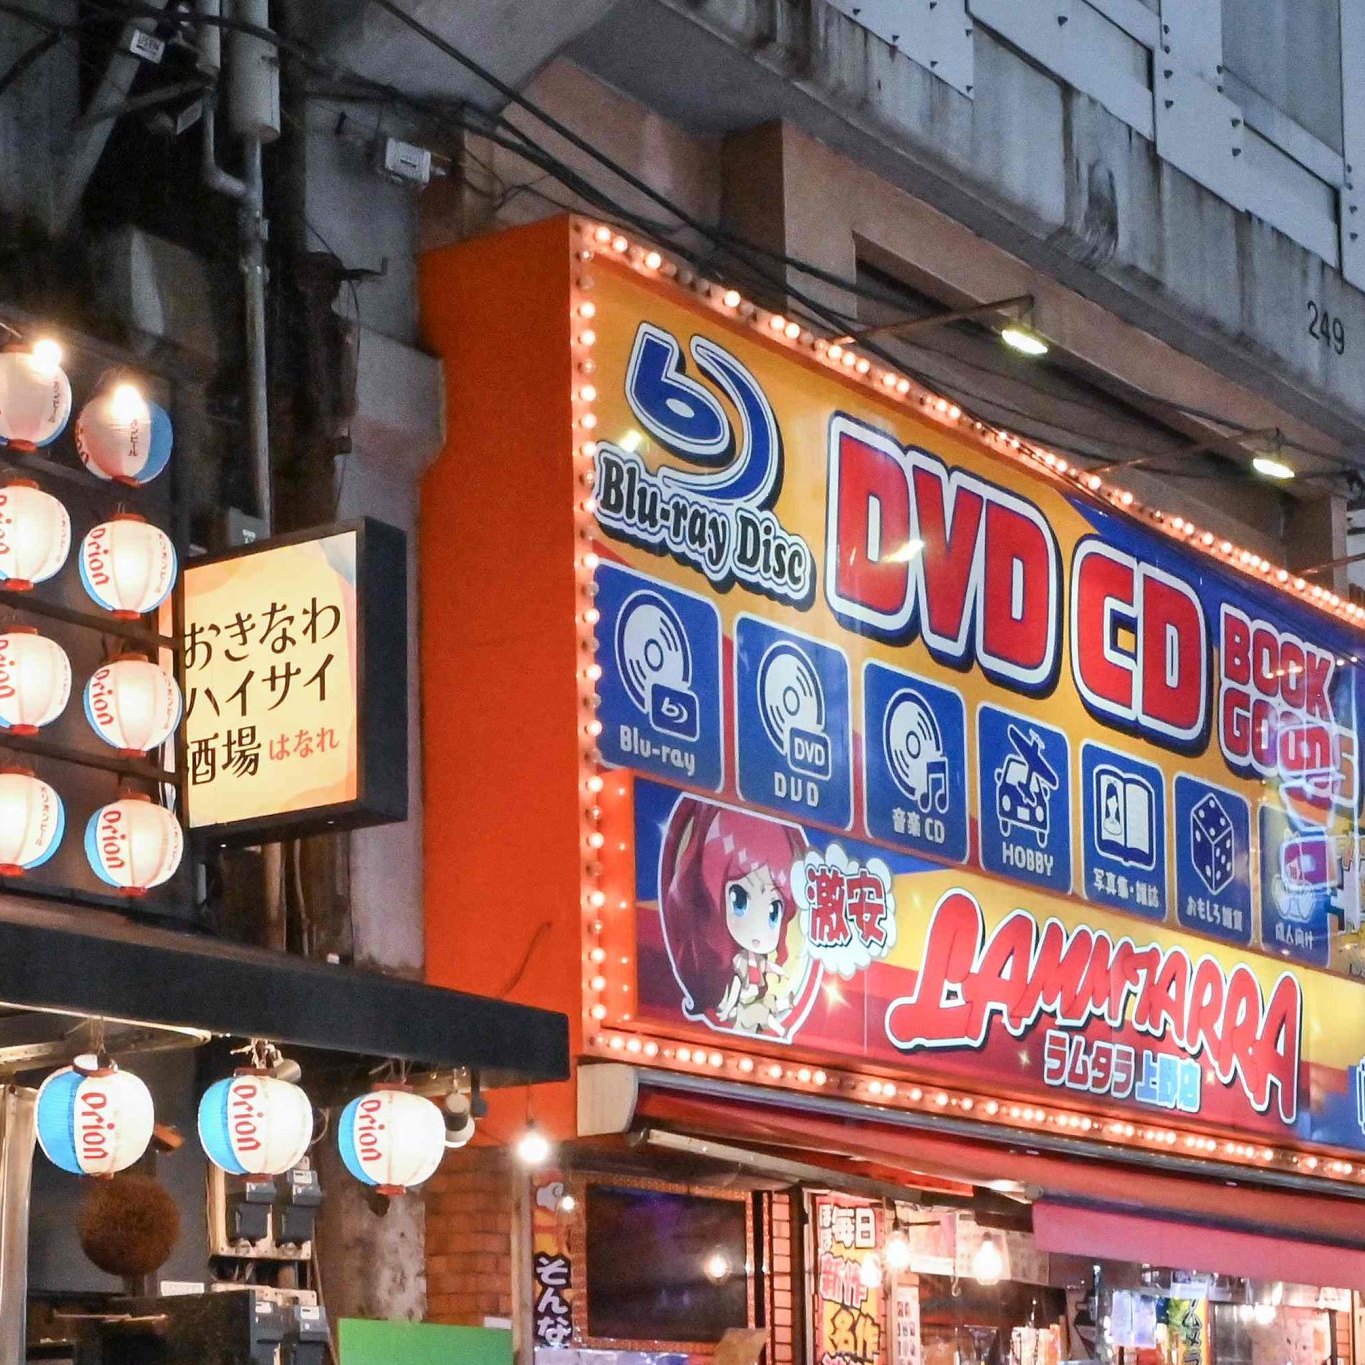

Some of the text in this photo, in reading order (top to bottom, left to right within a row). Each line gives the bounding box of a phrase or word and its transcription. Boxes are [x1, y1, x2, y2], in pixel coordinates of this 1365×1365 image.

[1306, 300, 1346, 357] 249
[601, 456, 808, 588] Blu-ray Disc
[88, 527, 111, 587] Orion
[830, 420, 1206, 735] DVD CD
[184, 598, 342, 673] おきなわ
[1221, 604, 1334, 722] BOOK
[91, 668, 114, 727] Orion
[185, 653, 335, 720] ハイサイ
[187, 725, 340, 787] 酒場 はなれ
[619, 725, 697, 776] Blu-ray
[793, 732, 827, 766] DVD
[102, 810, 127, 870] Orion
[925, 816, 947, 844] CD
[1001, 841, 1056, 874] HOBBY
[806, 862, 888, 949] 激安
[887, 888, 1303, 1124] LAMMTARRA
[1043, 1029, 1135, 1099] ラムタラ
[81, 1091, 115, 1160] Orion
[231, 1083, 265, 1153] Orion
[358, 1097, 386, 1163] Orion
[832, 1206, 877, 1249] 毎日
[535, 1256, 573, 1348] そんな
[829, 1308, 882, 1363] 名作
